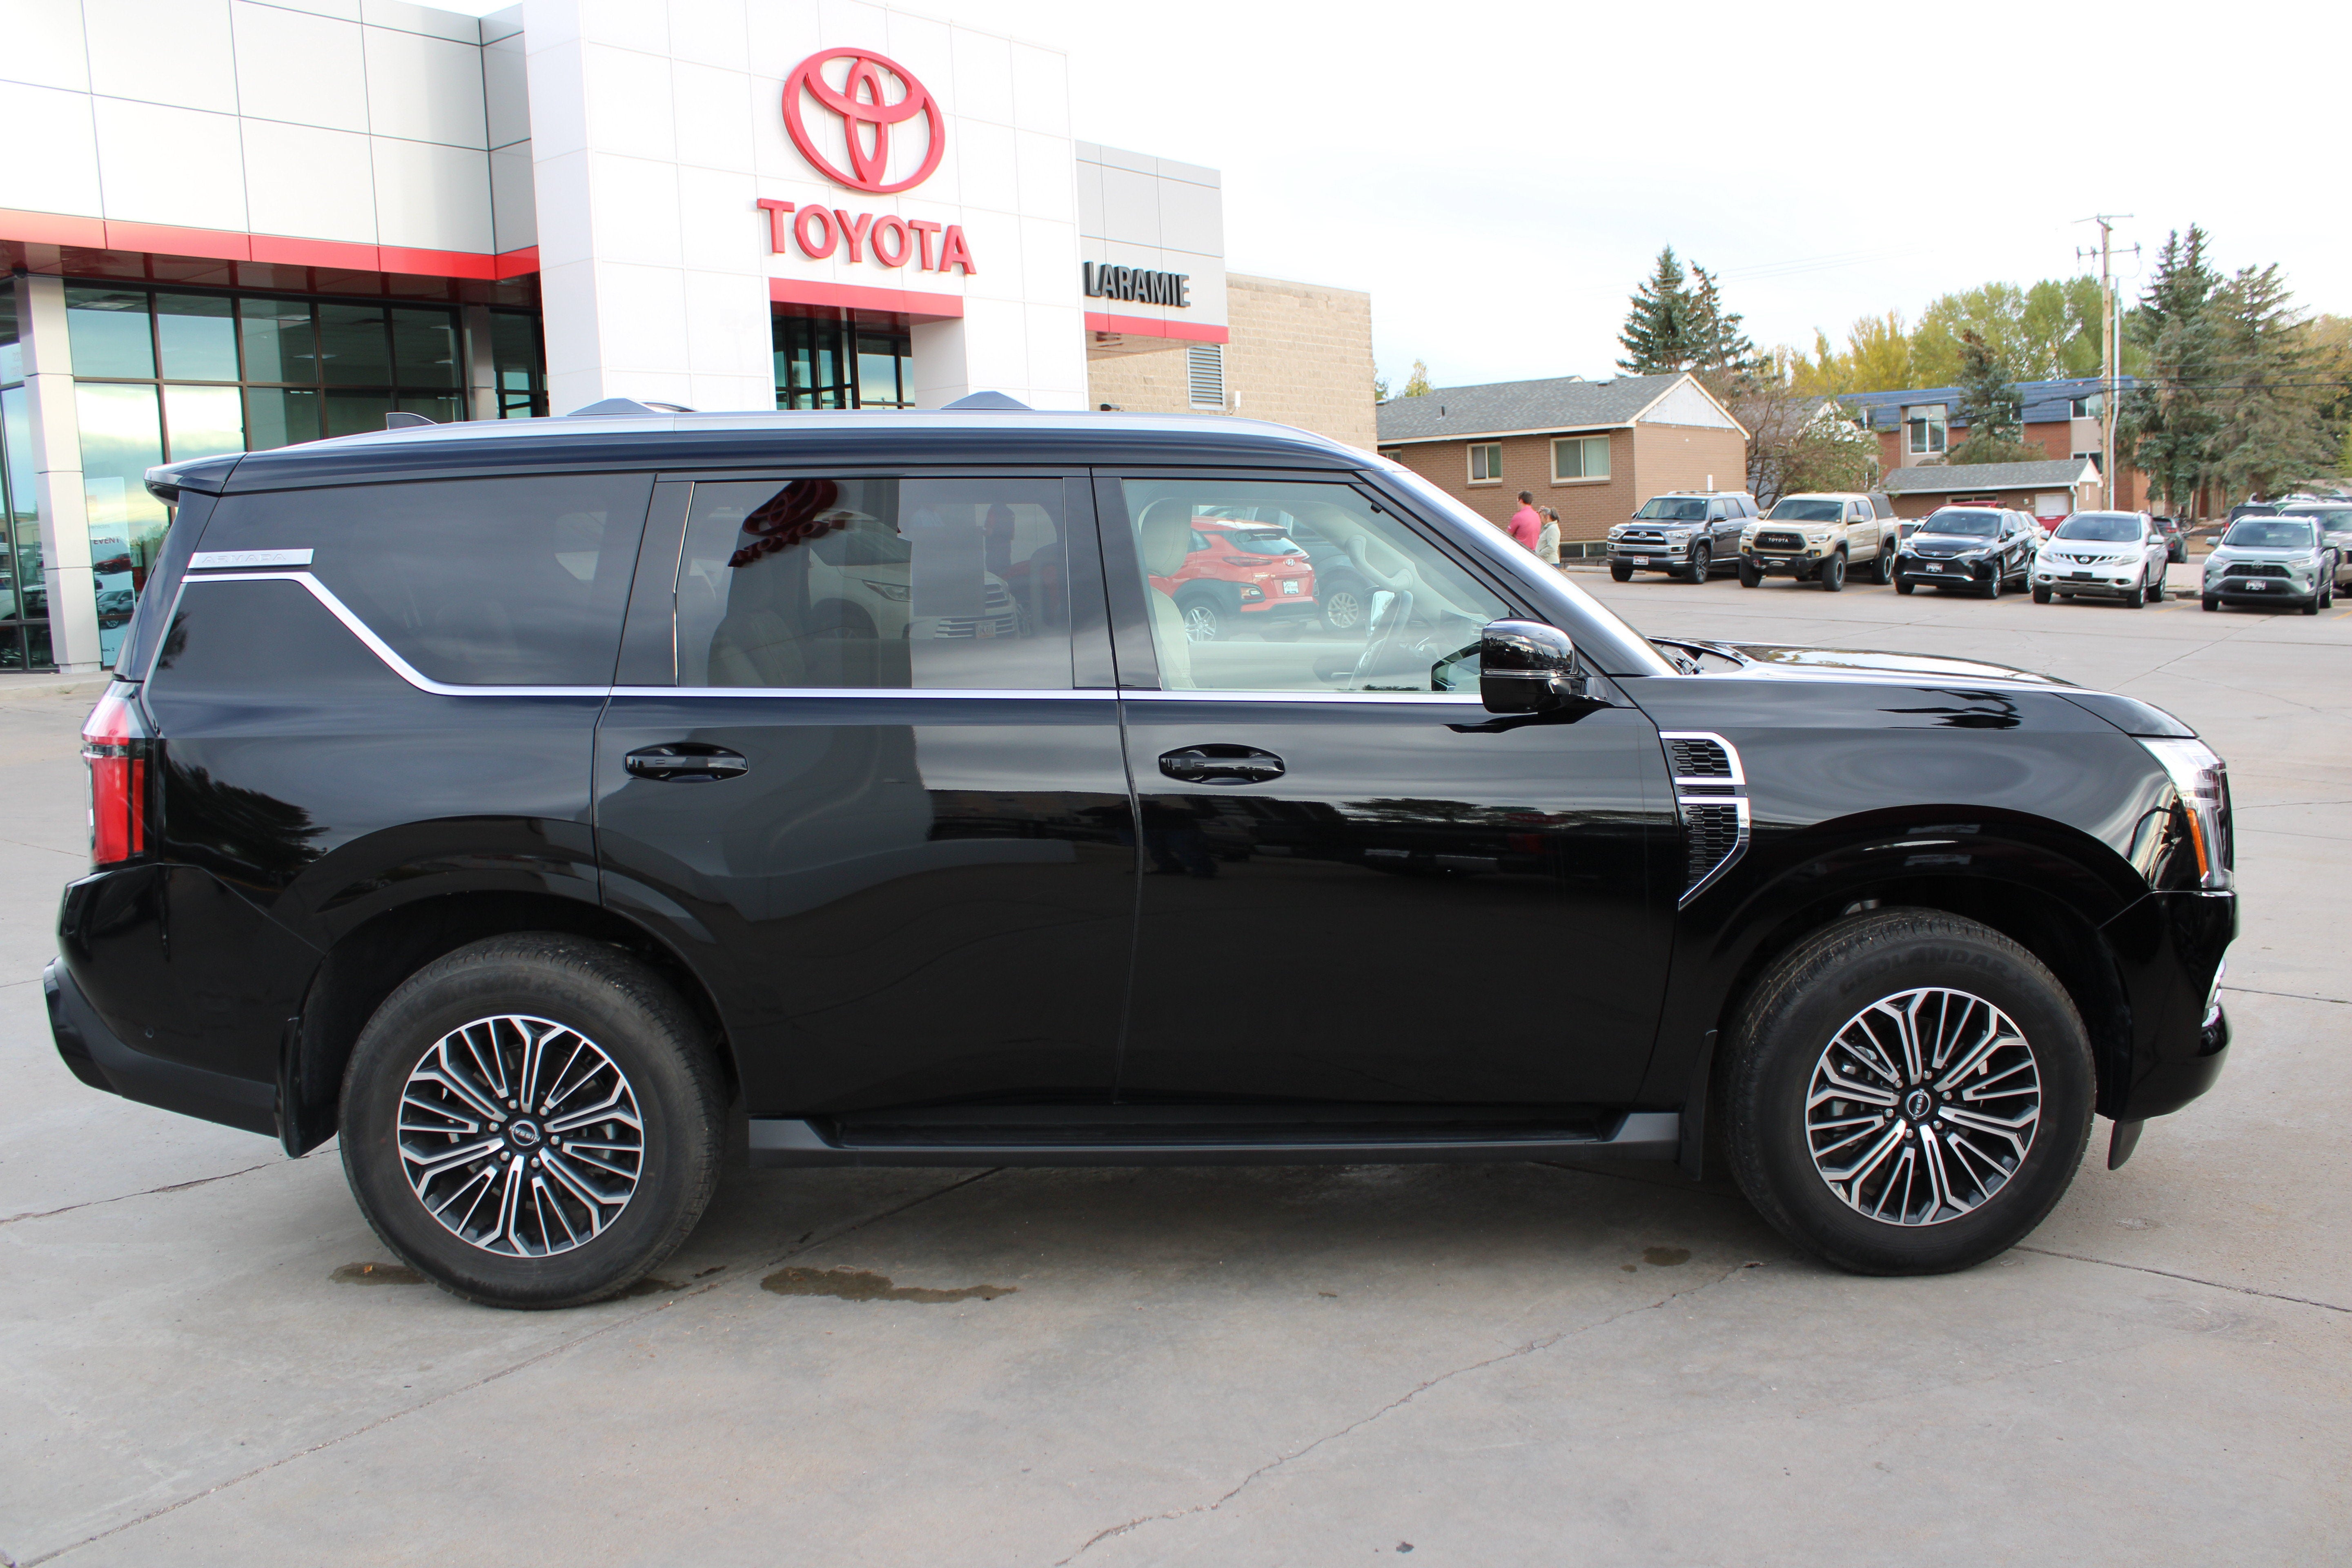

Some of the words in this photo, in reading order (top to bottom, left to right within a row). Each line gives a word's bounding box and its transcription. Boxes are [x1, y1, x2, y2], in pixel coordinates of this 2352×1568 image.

[757, 198, 977, 275] TOYOTA
[1084, 261, 1192, 308] LARAMIE
[94, 536, 120, 545] EVENT
[202, 553, 286, 564] ARMADA
[1913, 1088, 1925, 1120] NISSAN
[508, 1125, 541, 1142] NISSAN
